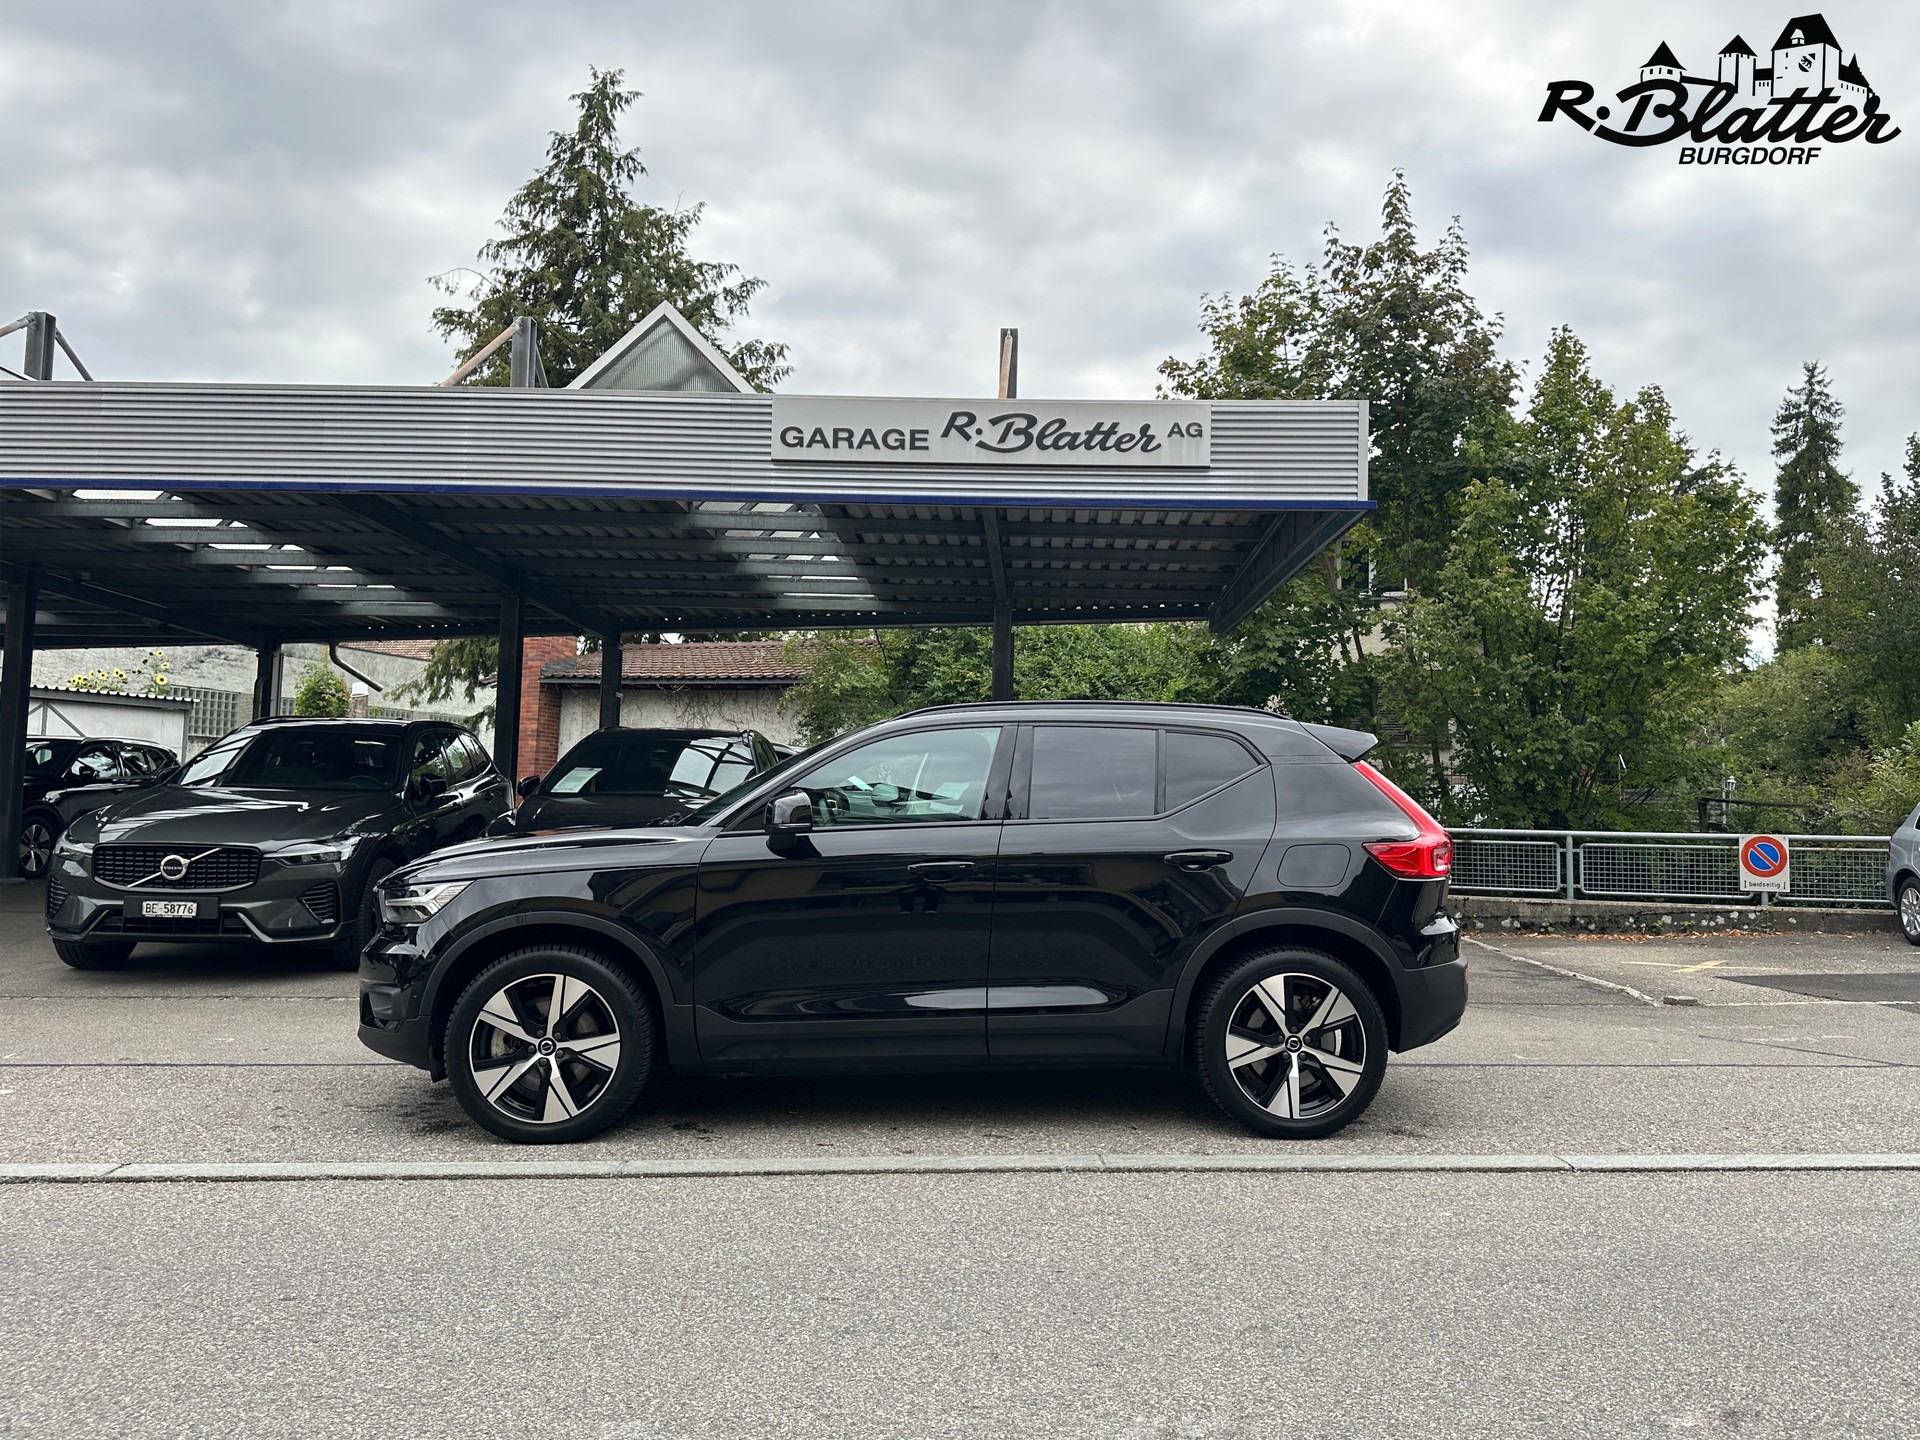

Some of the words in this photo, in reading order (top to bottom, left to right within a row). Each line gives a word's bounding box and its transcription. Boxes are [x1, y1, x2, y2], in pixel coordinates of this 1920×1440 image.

[779, 426, 930, 451] GARAGE
[1168, 422, 1203, 438] AG
[1748, 881, 1781, 889] beidseitig
[145, 903, 158, 914] BE
[163, 903, 194, 915] 58776
